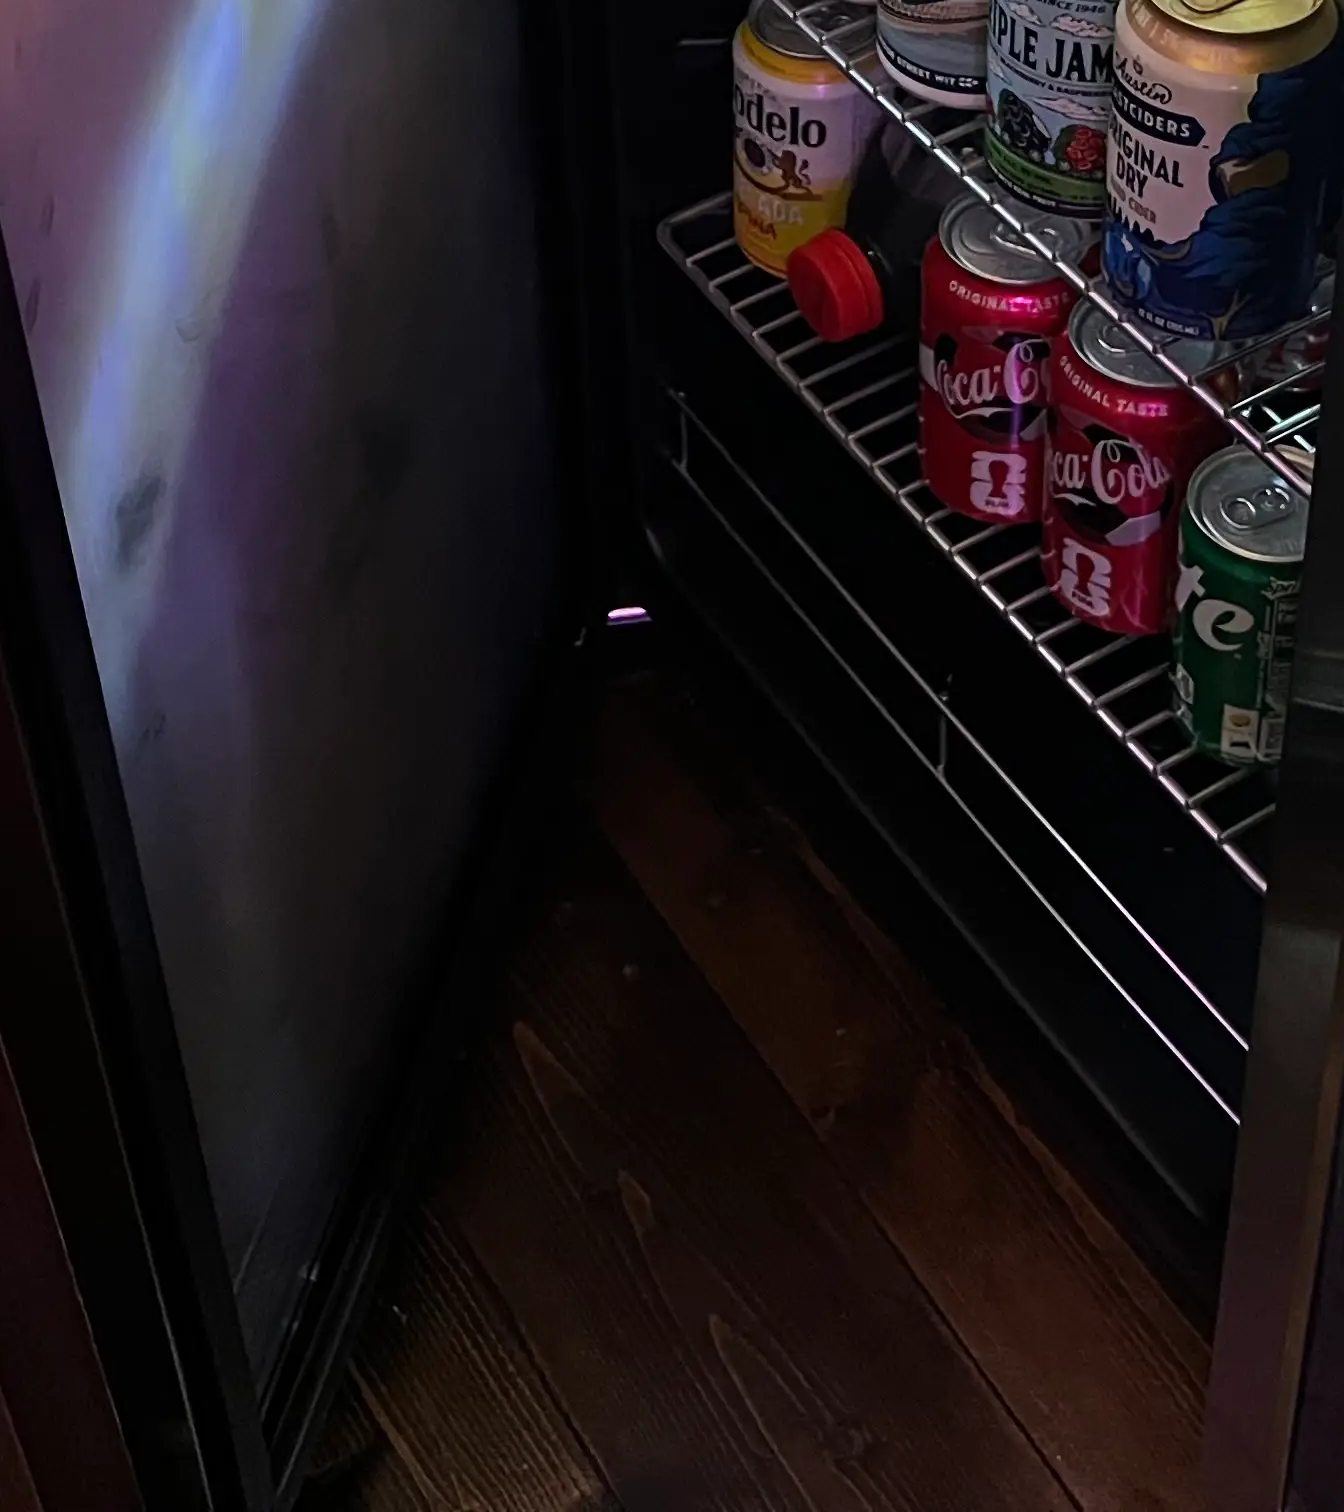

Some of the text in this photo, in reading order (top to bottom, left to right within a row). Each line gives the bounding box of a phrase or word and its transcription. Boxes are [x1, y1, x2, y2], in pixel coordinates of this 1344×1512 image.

[1045, 37, 1116, 85] JAM
[1116, 50, 1173, 105] Austin
[1114, 90, 1191, 140] STCIDERS
[1109, 111, 1185, 189] RIGINAL
[1115, 151, 1149, 199] DRY
[948, 279, 1071, 314] ORIGINAL TASTE
[936, 338, 1053, 407] Coca-C
[1059, 354, 1170, 418] ORIGINAL TASTE
[1048, 439, 1173, 506] ca-Cola
